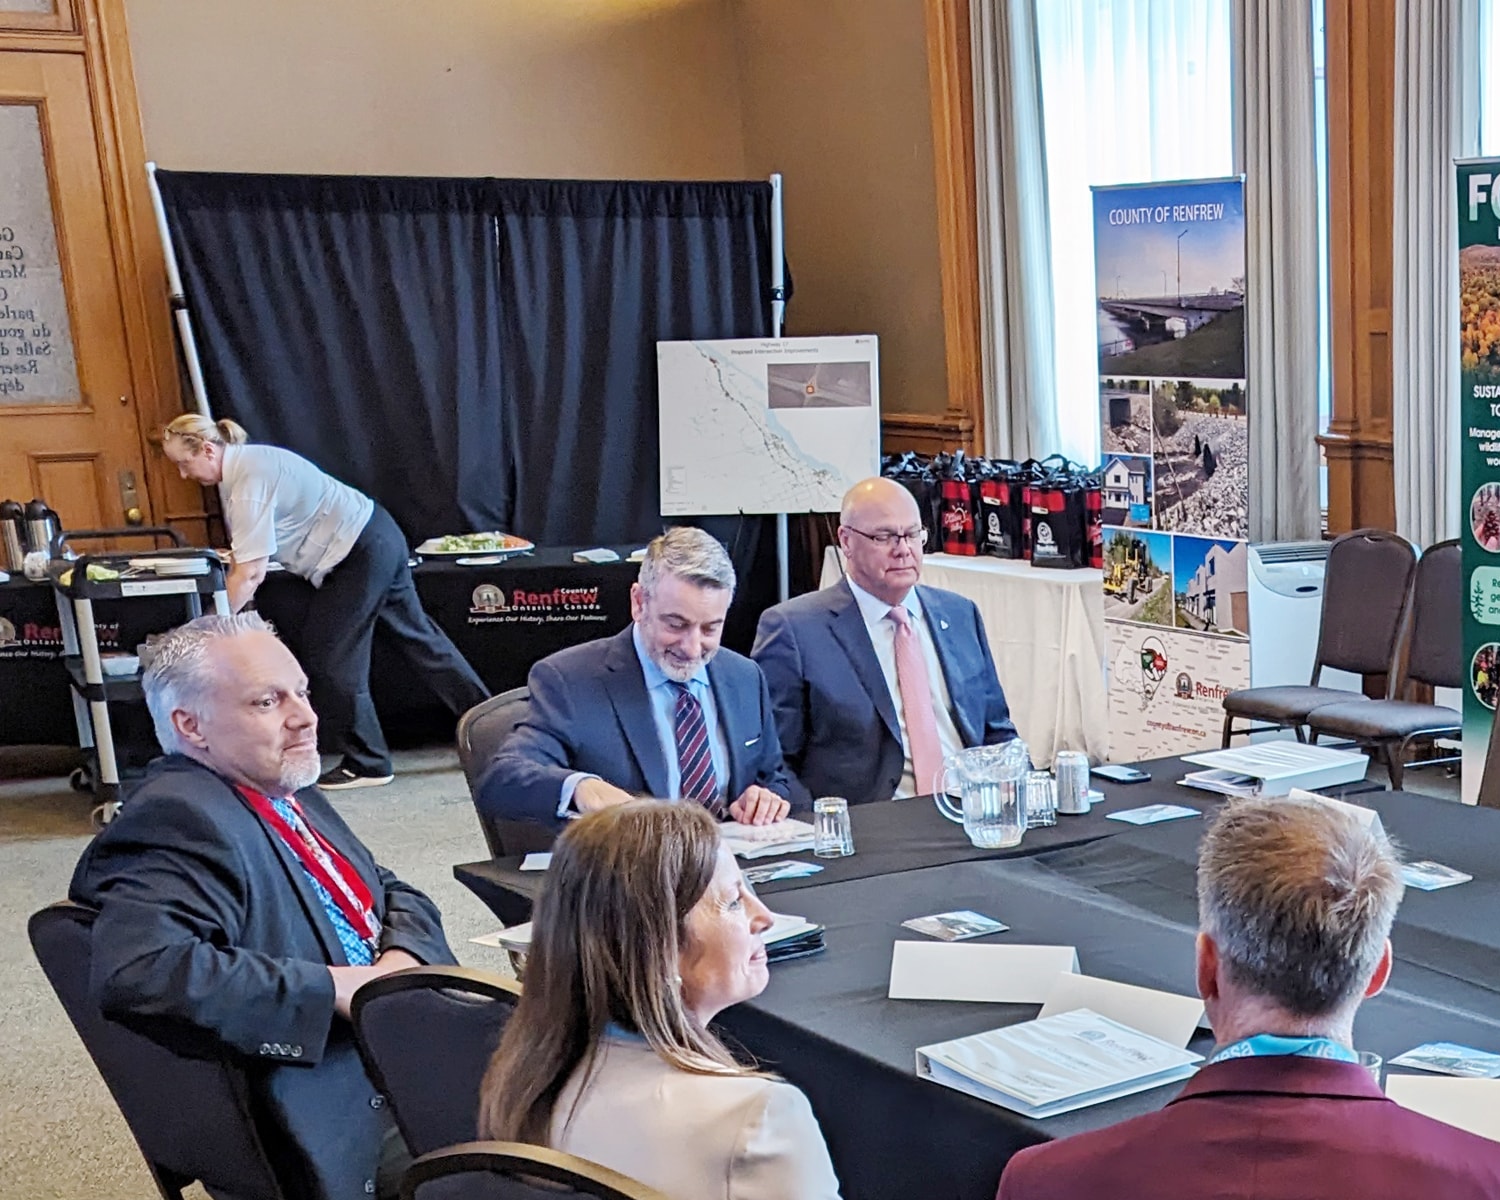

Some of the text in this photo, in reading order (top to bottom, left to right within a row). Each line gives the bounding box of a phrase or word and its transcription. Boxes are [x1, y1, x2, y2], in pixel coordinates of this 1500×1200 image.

[1109, 203, 1224, 225] COUNTY OF RENFREW
[513, 588, 598, 606] Renfrew
[561, 587, 588, 595] County
[511, 603, 601, 612] Ontario Canada
[1195, 681, 1228, 700] Renfre
